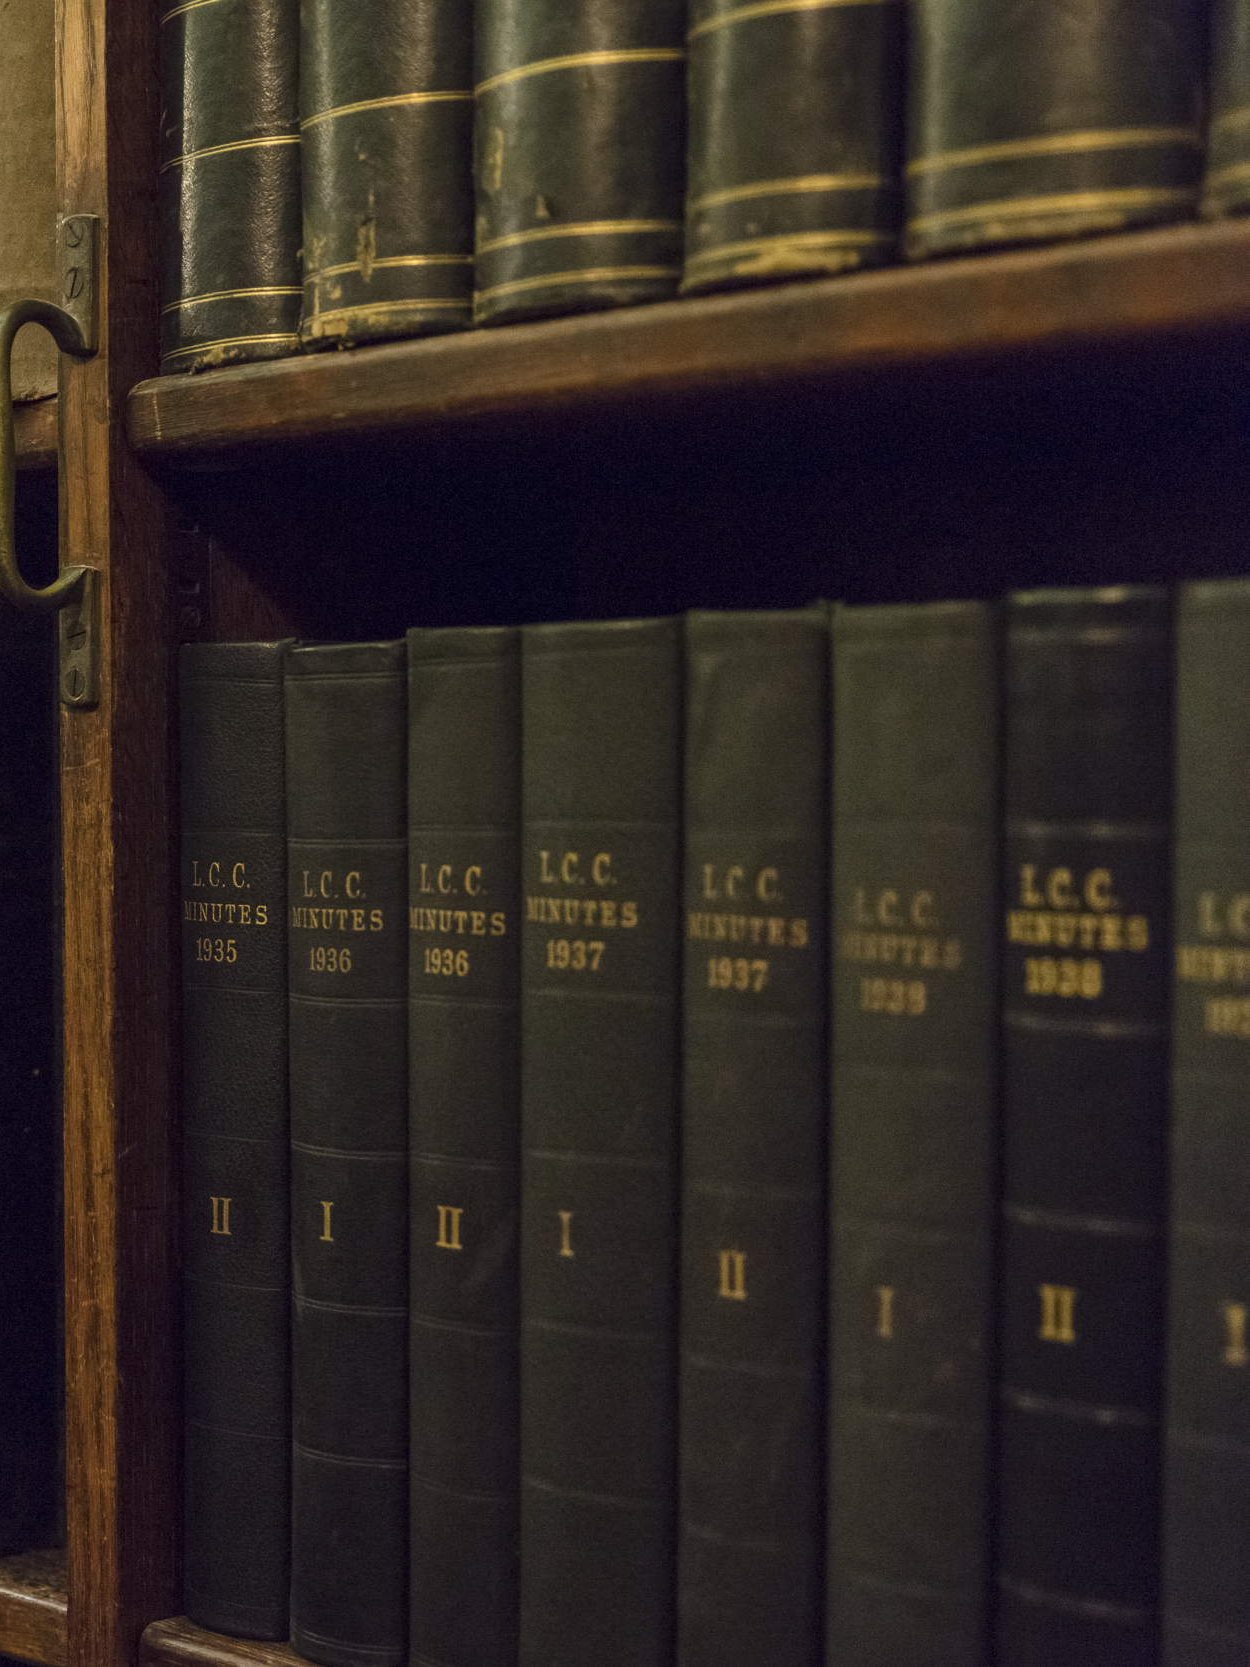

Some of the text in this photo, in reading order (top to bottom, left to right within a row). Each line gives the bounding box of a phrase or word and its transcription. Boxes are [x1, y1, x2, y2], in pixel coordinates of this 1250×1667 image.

[184, 900, 269, 926] MINUTES
[292, 906, 384, 932] MINUTES
[408, 907, 506, 936] MINUTES
[526, 896, 638, 929] MINUTES
[195, 937, 238, 963] 1935
[308, 946, 352, 974] 1936
[423, 947, 469, 978] 1936
[546, 938, 606, 972] 1937
[707, 956, 769, 992] 1937
[209, 1196, 233, 1235] II
[436, 1204, 464, 1250] II
